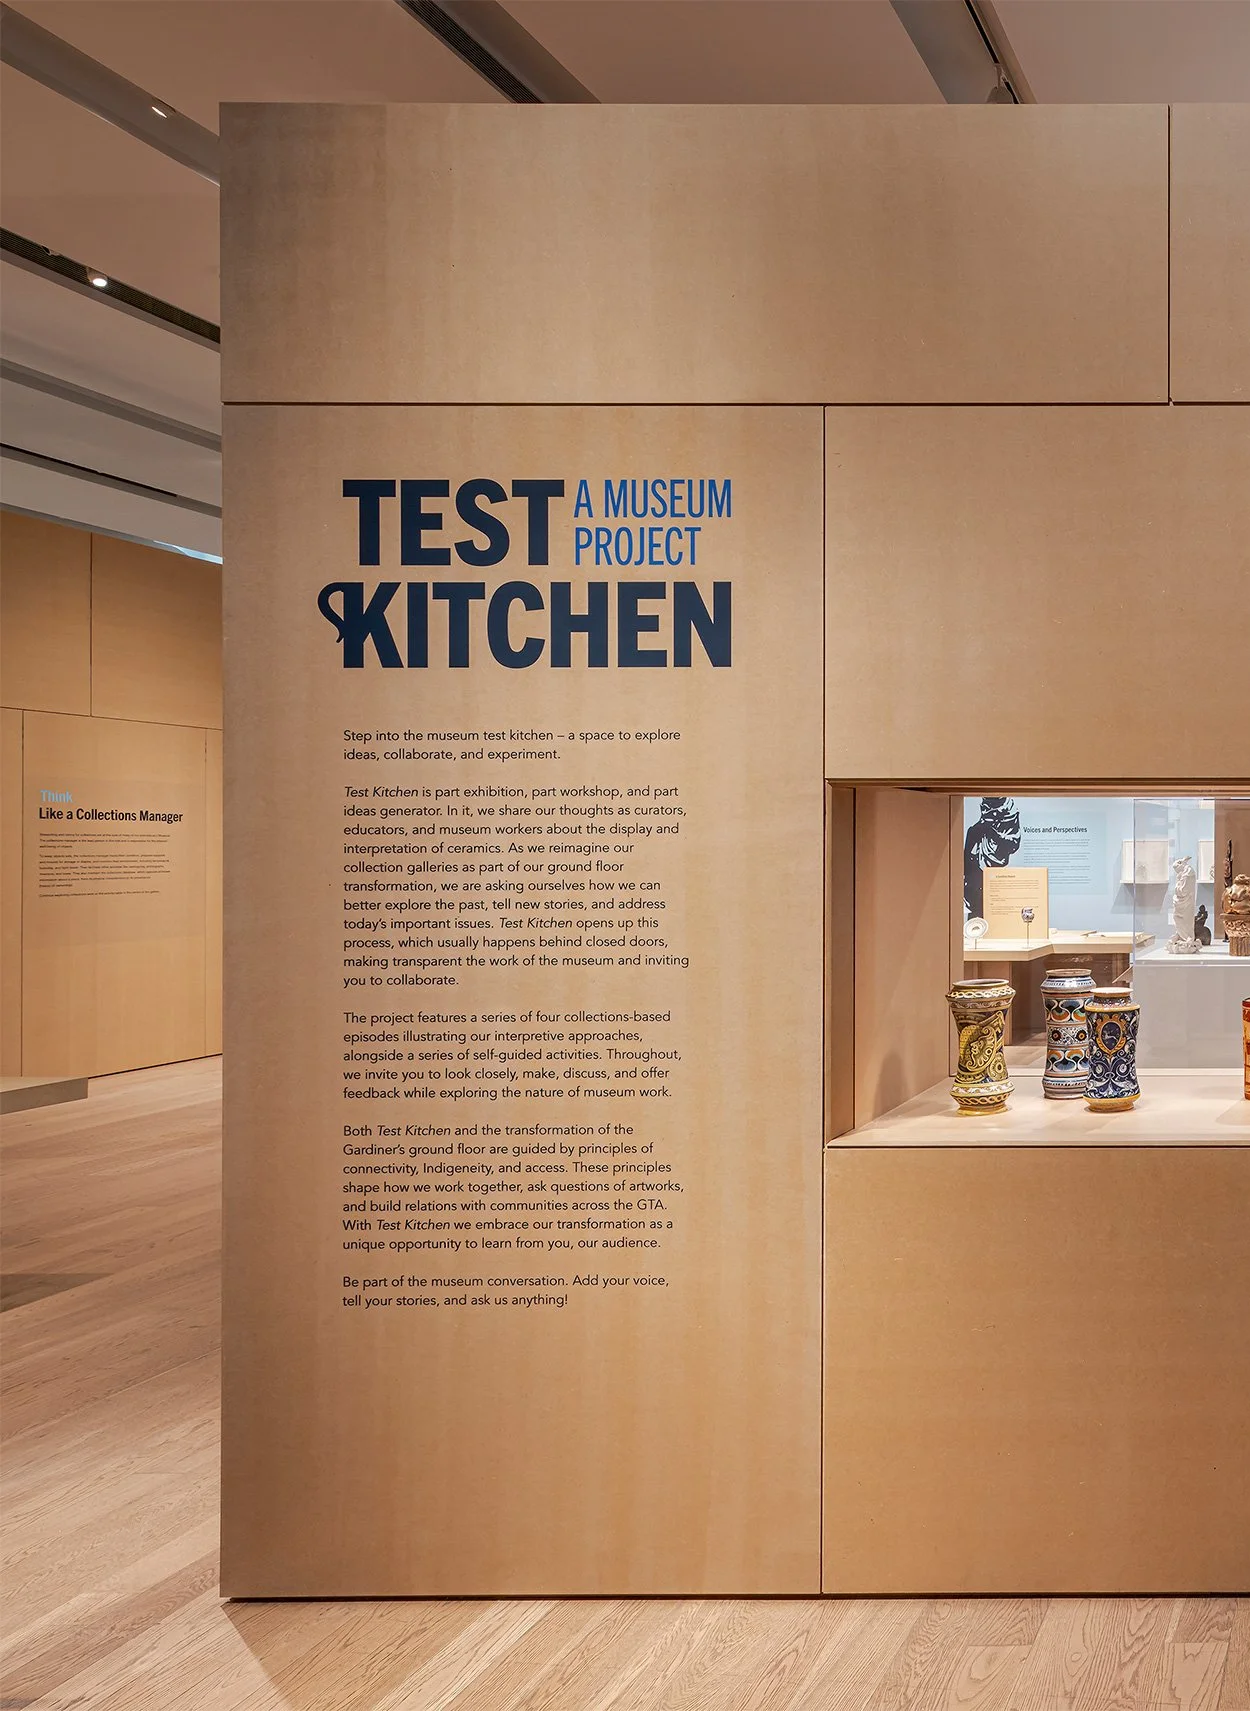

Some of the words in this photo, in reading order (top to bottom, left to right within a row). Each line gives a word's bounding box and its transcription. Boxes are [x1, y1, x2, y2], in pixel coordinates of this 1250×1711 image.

[342, 478, 565, 567] TEST
[574, 479, 594, 518] A
[604, 479, 732, 519] MUSEUM
[575, 526, 702, 567] PROJECT
[317, 581, 732, 669] KITCHEN
[344, 748, 380, 761] ideas,
[383, 748, 456, 761] collaborate,
[460, 747, 484, 760] and
[487, 748, 561, 763] experiment.
[40, 789, 73, 803] Think
[344, 786, 369, 798] Test
[372, 785, 419, 798] Kitchen
[422, 786, 432, 797] is
[435, 788, 460, 801] part
[463, 785, 528, 799] exhibition,
[532, 787, 557, 800] part
[560, 785, 623, 800] workshop,
[627, 785, 650, 797] and
[654, 787, 679, 800] part
[39, 807, 64, 820] Like
[66, 811, 73, 820] a
[76, 808, 137, 821] Collections
[139, 810, 183, 824] Manager
[343, 823, 408, 837] educators,
[412, 823, 435, 835] and
[439, 826, 491, 835] museum
[495, 823, 543, 835] workers
[546, 823, 582, 835] about
[586, 822, 606, 834] the
[609, 822, 653, 838] display
[656, 822, 679, 834] and
[1023, 826, 1041, 834] Voices
[1042, 826, 1052, 834] and
[1053, 826, 1087, 834] Perspectives
[344, 843, 427, 857] interpretation
[431, 841, 444, 854] of
[447, 842, 504, 854] ceramics.
[508, 842, 524, 853] As
[527, 845, 545, 853] we
[549, 842, 610, 856] reimagine
[613, 845, 634, 853] our
[343, 939, 394, 952] process,
[398, 936, 433, 948] which
[437, 936, 479, 951] usually
[483, 935, 536, 951] happens
[539, 935, 582, 947] behind
[586, 935, 626, 947] closed
[629, 935, 668, 948] doors,
[343, 977, 366, 989] you
[370, 976, 383, 986] to
[386, 973, 459, 986] collaborate.
[343, 1012, 367, 1023] The
[370, 1012, 414, 1027] project
[417, 1011, 467, 1023] features
[470, 1014, 477, 1023] a
[481, 1012, 516, 1023] series
[520, 1010, 533, 1023] of
[536, 1010, 561, 1022] four
[564, 1010, 671, 1022] collections-based
[343, 1030, 399, 1046] episodes
[403, 1030, 466, 1045] illustrating
[470, 1033, 491, 1042] our
[495, 1030, 564, 1045] interpretive
[568, 1029, 643, 1045] approaches,
[343, 1049, 404, 1064] alongside
[407, 1052, 414, 1061] a
[418, 1049, 454, 1061] series
[457, 1048, 470, 1061] of
[473, 1048, 542, 1063] self-guided
[546, 1049, 602, 1060] activities.
[606, 1048, 682, 1063] Throughout,
[343, 1124, 372, 1136] Both
[377, 1125, 402, 1136] Test
[405, 1124, 451, 1136] Kitchen
[454, 1124, 478, 1136] and
[481, 1124, 501, 1136] the
[505, 1123, 594, 1136] transformation
[598, 1123, 611, 1135] of
[614, 1123, 634, 1135] the
[343, 1143, 405, 1156] Gardiner’s
[408, 1143, 453, 1158] ground
[457, 1142, 486, 1155] floor
[489, 1146, 508, 1154] are
[512, 1142, 556, 1158] guided
[560, 1142, 575, 1157] by
[578, 1142, 637, 1158] principles
[641, 1141, 654, 1154] of
[343, 1163, 419, 1177] connectivity,
[423, 1162, 494, 1177] Indigeneity,
[498, 1161, 521, 1173] and
[525, 1164, 568, 1173] access.
[572, 1161, 609, 1173] These
[613, 1161, 672, 1176] principles
[343, 1276, 359, 1287] Be
[363, 1277, 388, 1291] part
[391, 1275, 405, 1287] of
[407, 1275, 427, 1287] the
[431, 1278, 483, 1287] museum
[487, 1275, 568, 1287] conversation.
[572, 1274, 599, 1286] Add
[602, 1277, 630, 1289] your
[633, 1274, 669, 1287] voice,
[342, 1294, 361, 1306] tell
[365, 1298, 393, 1309] your
[396, 1294, 440, 1307] stories,
[444, 1294, 467, 1306] and
[471, 1293, 491, 1305] ask
[494, 1297, 508, 1305] us
[511, 1293, 568, 1308] anything!
